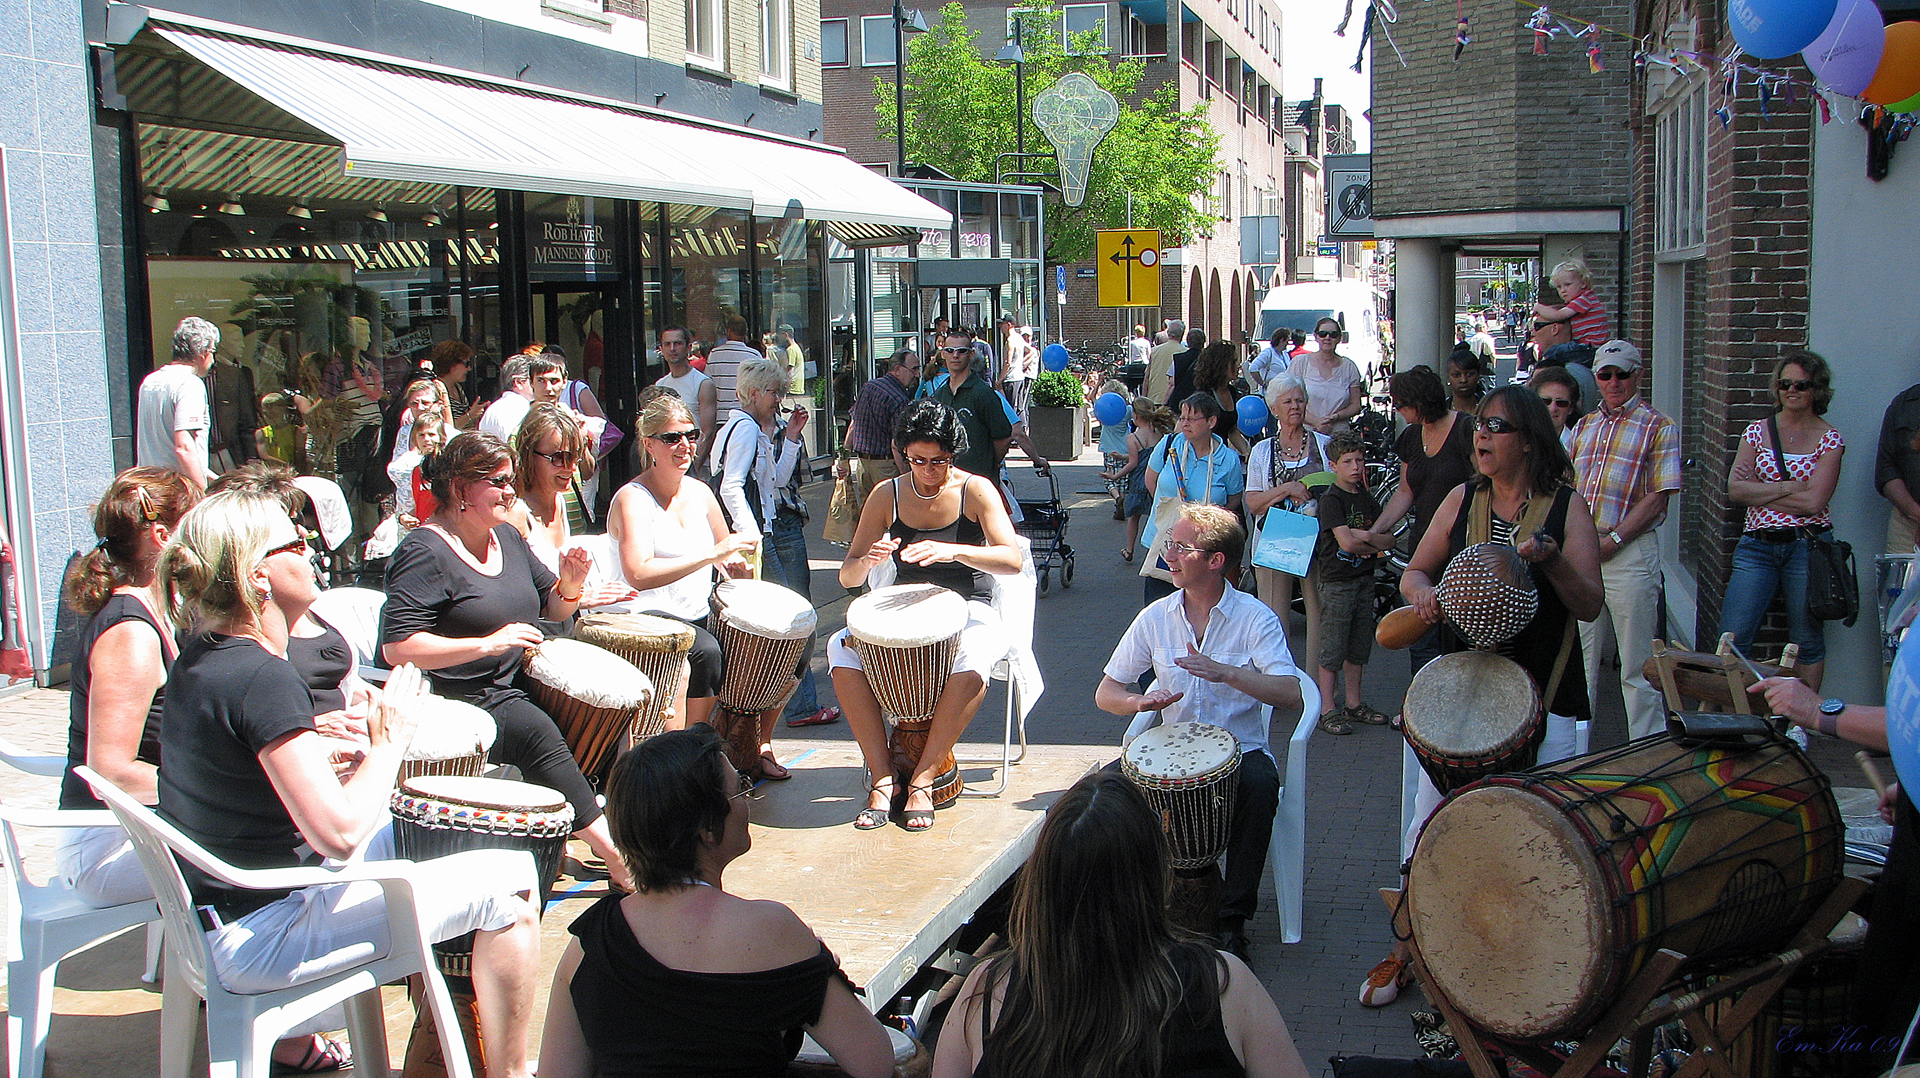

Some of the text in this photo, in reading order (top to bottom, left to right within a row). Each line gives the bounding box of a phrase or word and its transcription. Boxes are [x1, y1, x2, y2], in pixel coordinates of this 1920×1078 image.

[1346, 174, 1367, 182] ZONE
[543, 221, 604, 242] ROB HAVER
[534, 246, 613, 266] MANNENMODE
